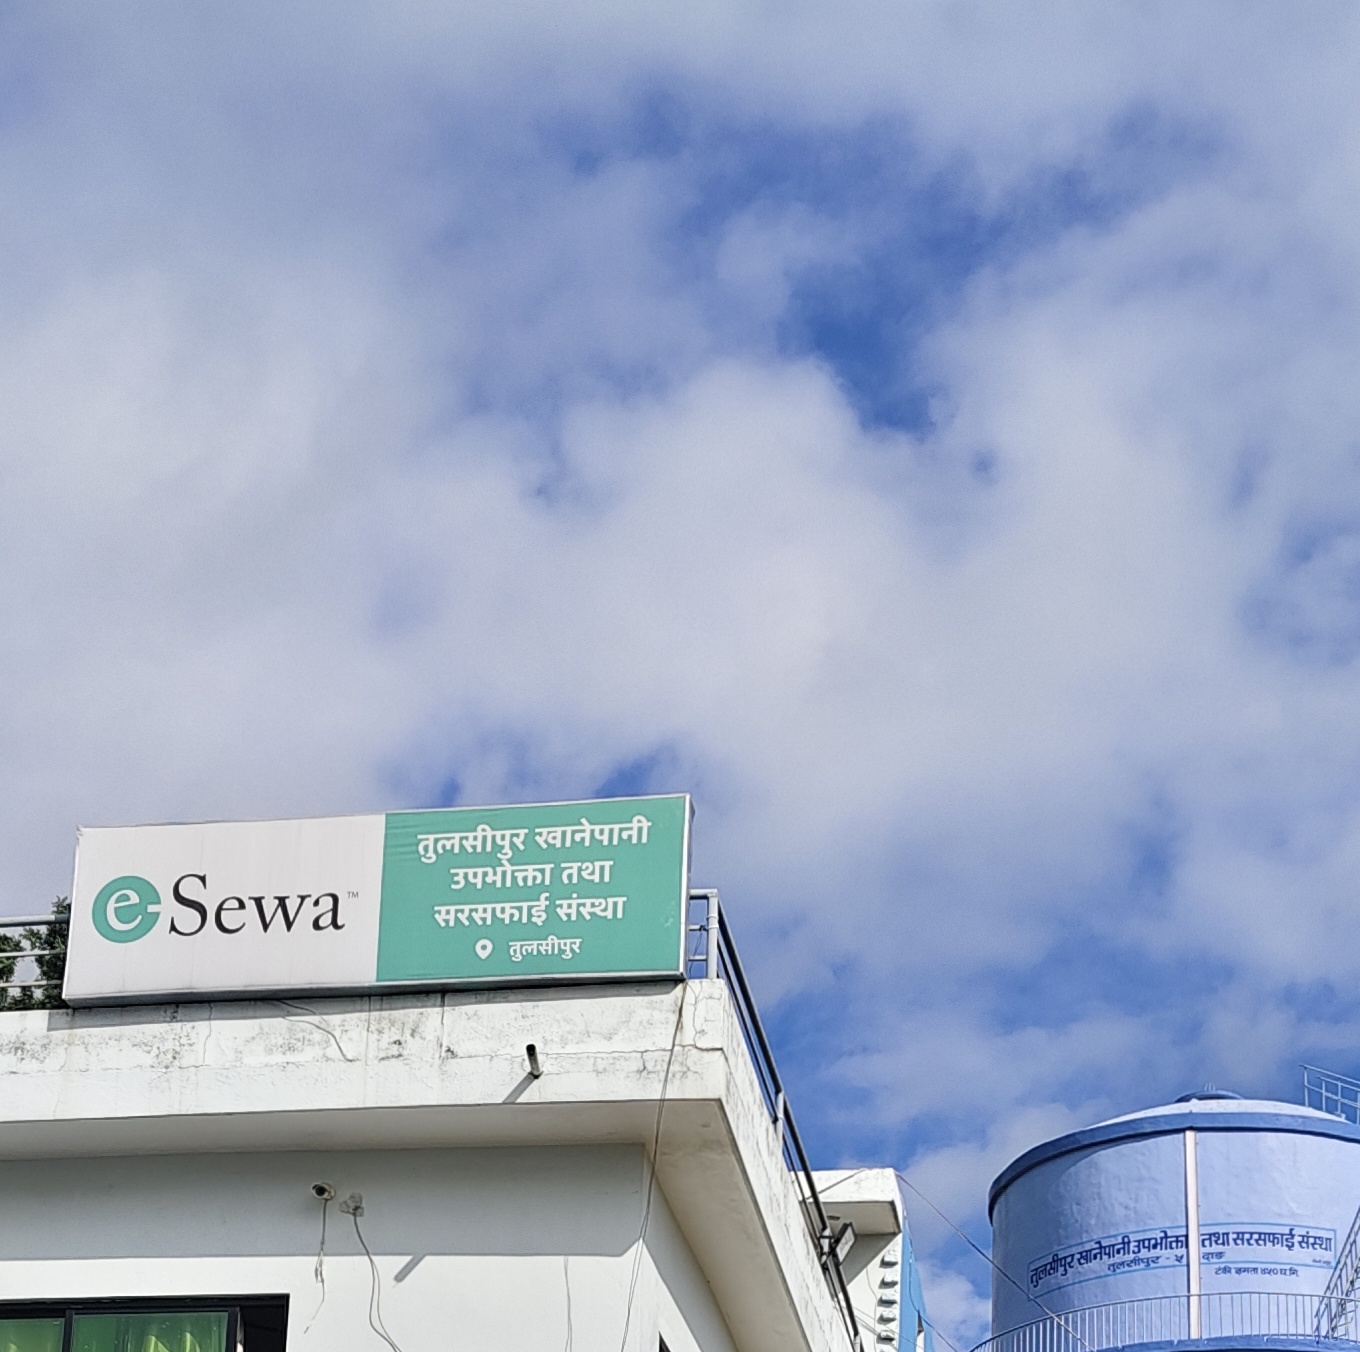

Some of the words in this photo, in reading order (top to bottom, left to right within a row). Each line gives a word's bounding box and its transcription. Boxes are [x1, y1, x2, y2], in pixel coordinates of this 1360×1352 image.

[417, 825, 528, 863] तुलसीपुर
[535, 815, 652, 849] खानेपानी
[450, 860, 554, 890] उपभोक्ता
[561, 861, 614, 884] तथा
[434, 893, 550, 927] सरसफाई
[556, 894, 627, 921] संस्था
[508, 935, 582, 962] तुलसीपुर
[1030, 1253, 1075, 1288] तुलसीपुर
[1077, 1235, 1131, 1266] खानेपानी
[1132, 1230, 1188, 1255] उपभोक्ता
[1200, 1232, 1230, 1248] तथा
[1232, 1228, 1296, 1251] सरसफाई
[1297, 1231, 1333, 1252] संस्था
[1107, 1255, 1162, 1273] तुलसीपुर
